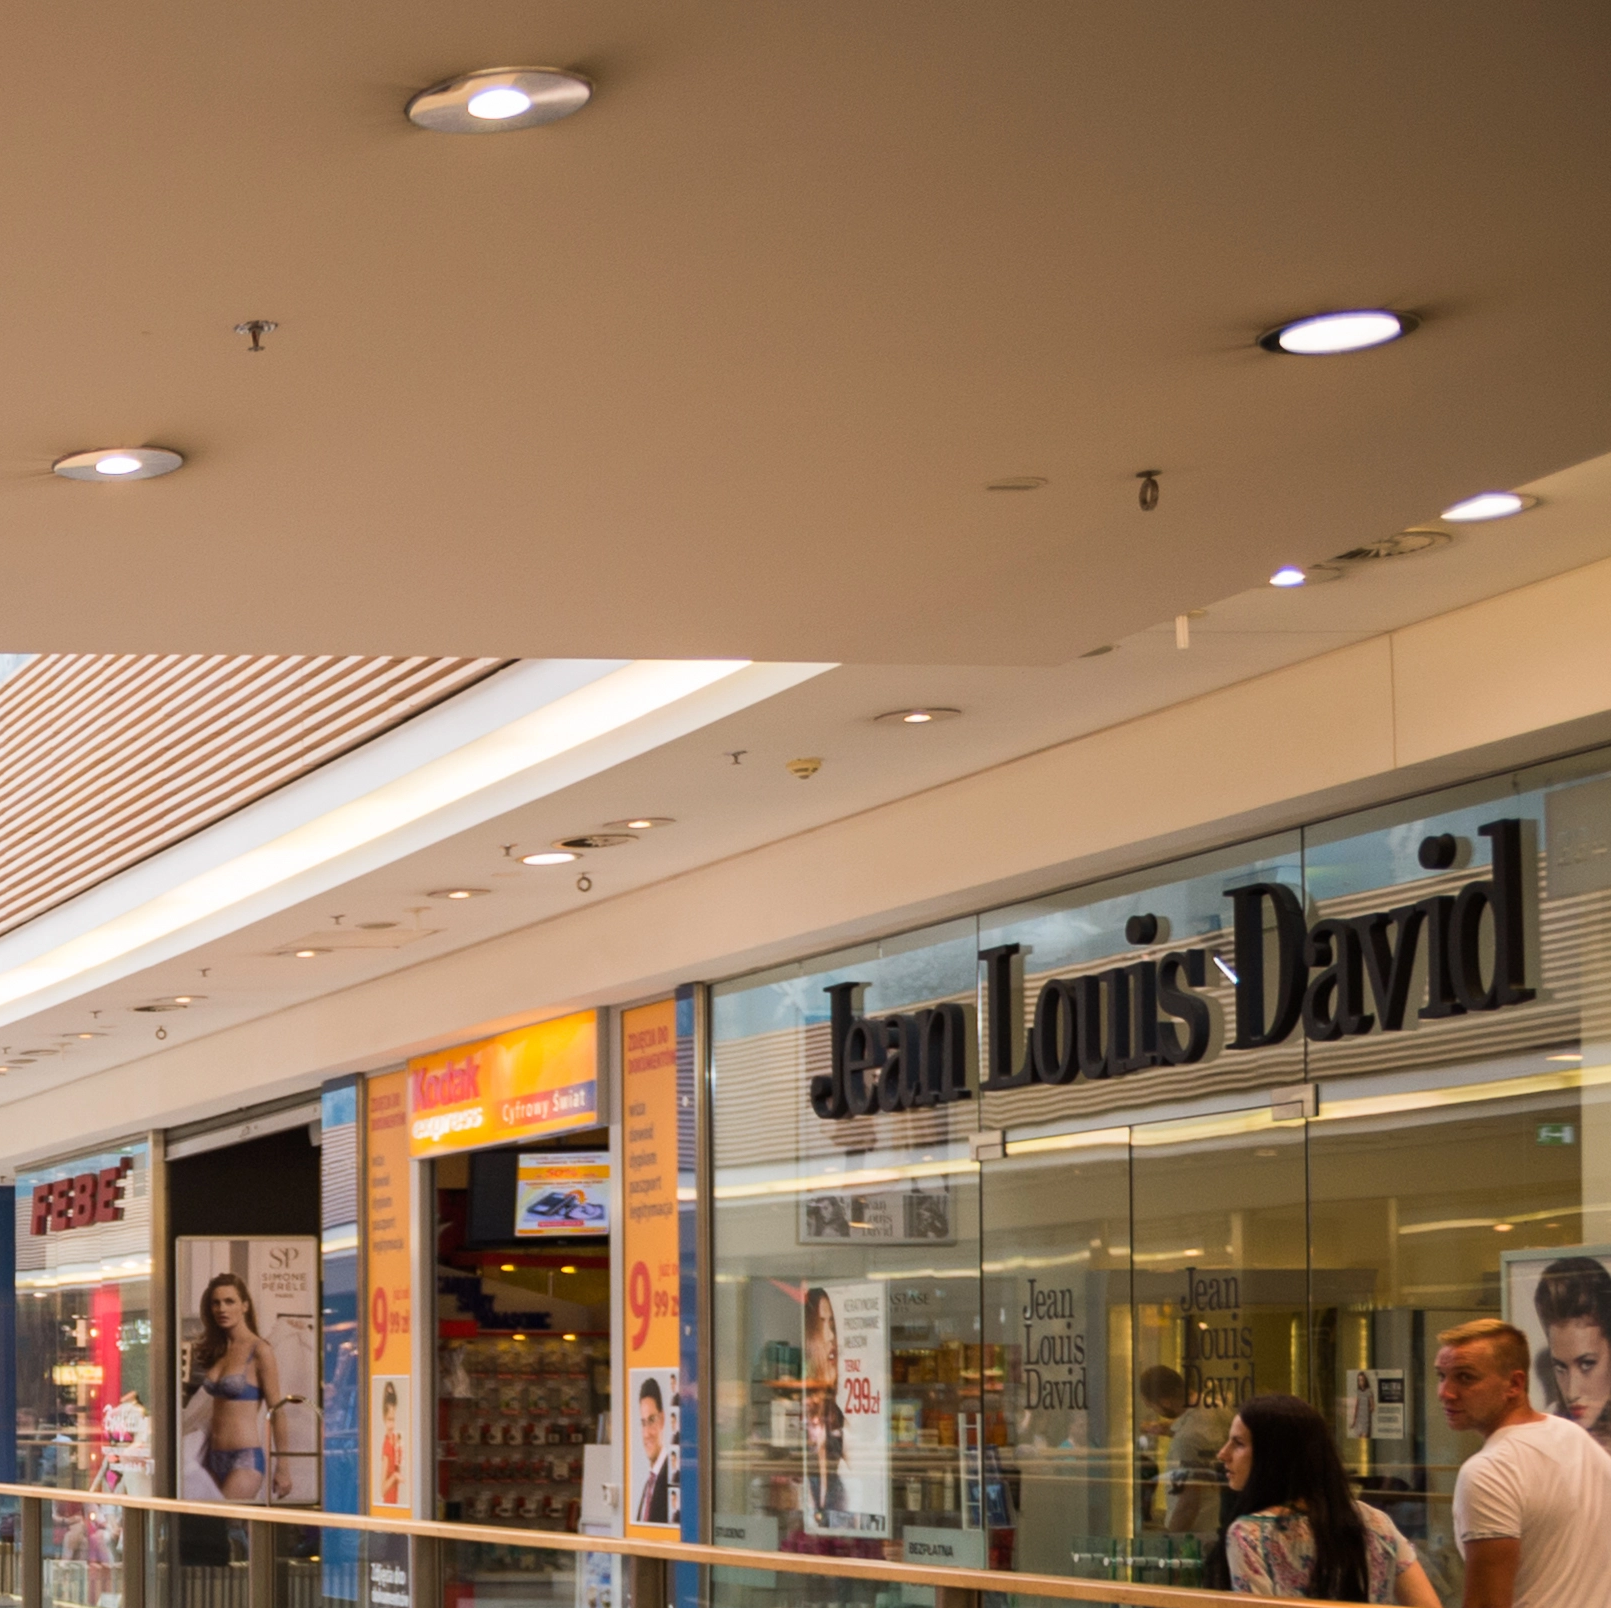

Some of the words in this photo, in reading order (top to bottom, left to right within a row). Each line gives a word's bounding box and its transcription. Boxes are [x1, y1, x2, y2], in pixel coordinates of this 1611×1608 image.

[811, 982, 971, 1120] Jean
[979, 914, 1209, 1093] Louis
[1225, 819, 1537, 1051] David
[412, 1056, 481, 1113] Kodak
[412, 1107, 483, 1141] express
[502, 1099, 550, 1124] Cyfrowy
[553, 1089, 585, 1112] Świat
[262, 1272, 307, 1283] SIMONE
[1181, 1267, 1240, 1311] Jean
[629, 1261, 651, 1351] 9
[1023, 1279, 1074, 1321] Jean
[372, 1286, 389, 1361] 9
[1024, 1322, 1085, 1365] Louis
[1182, 1312, 1253, 1361] Louis
[1024, 1367, 1088, 1410] David
[1182, 1362, 1255, 1408] David
[908, 1541, 954, 1559] BEZPŁATNA
